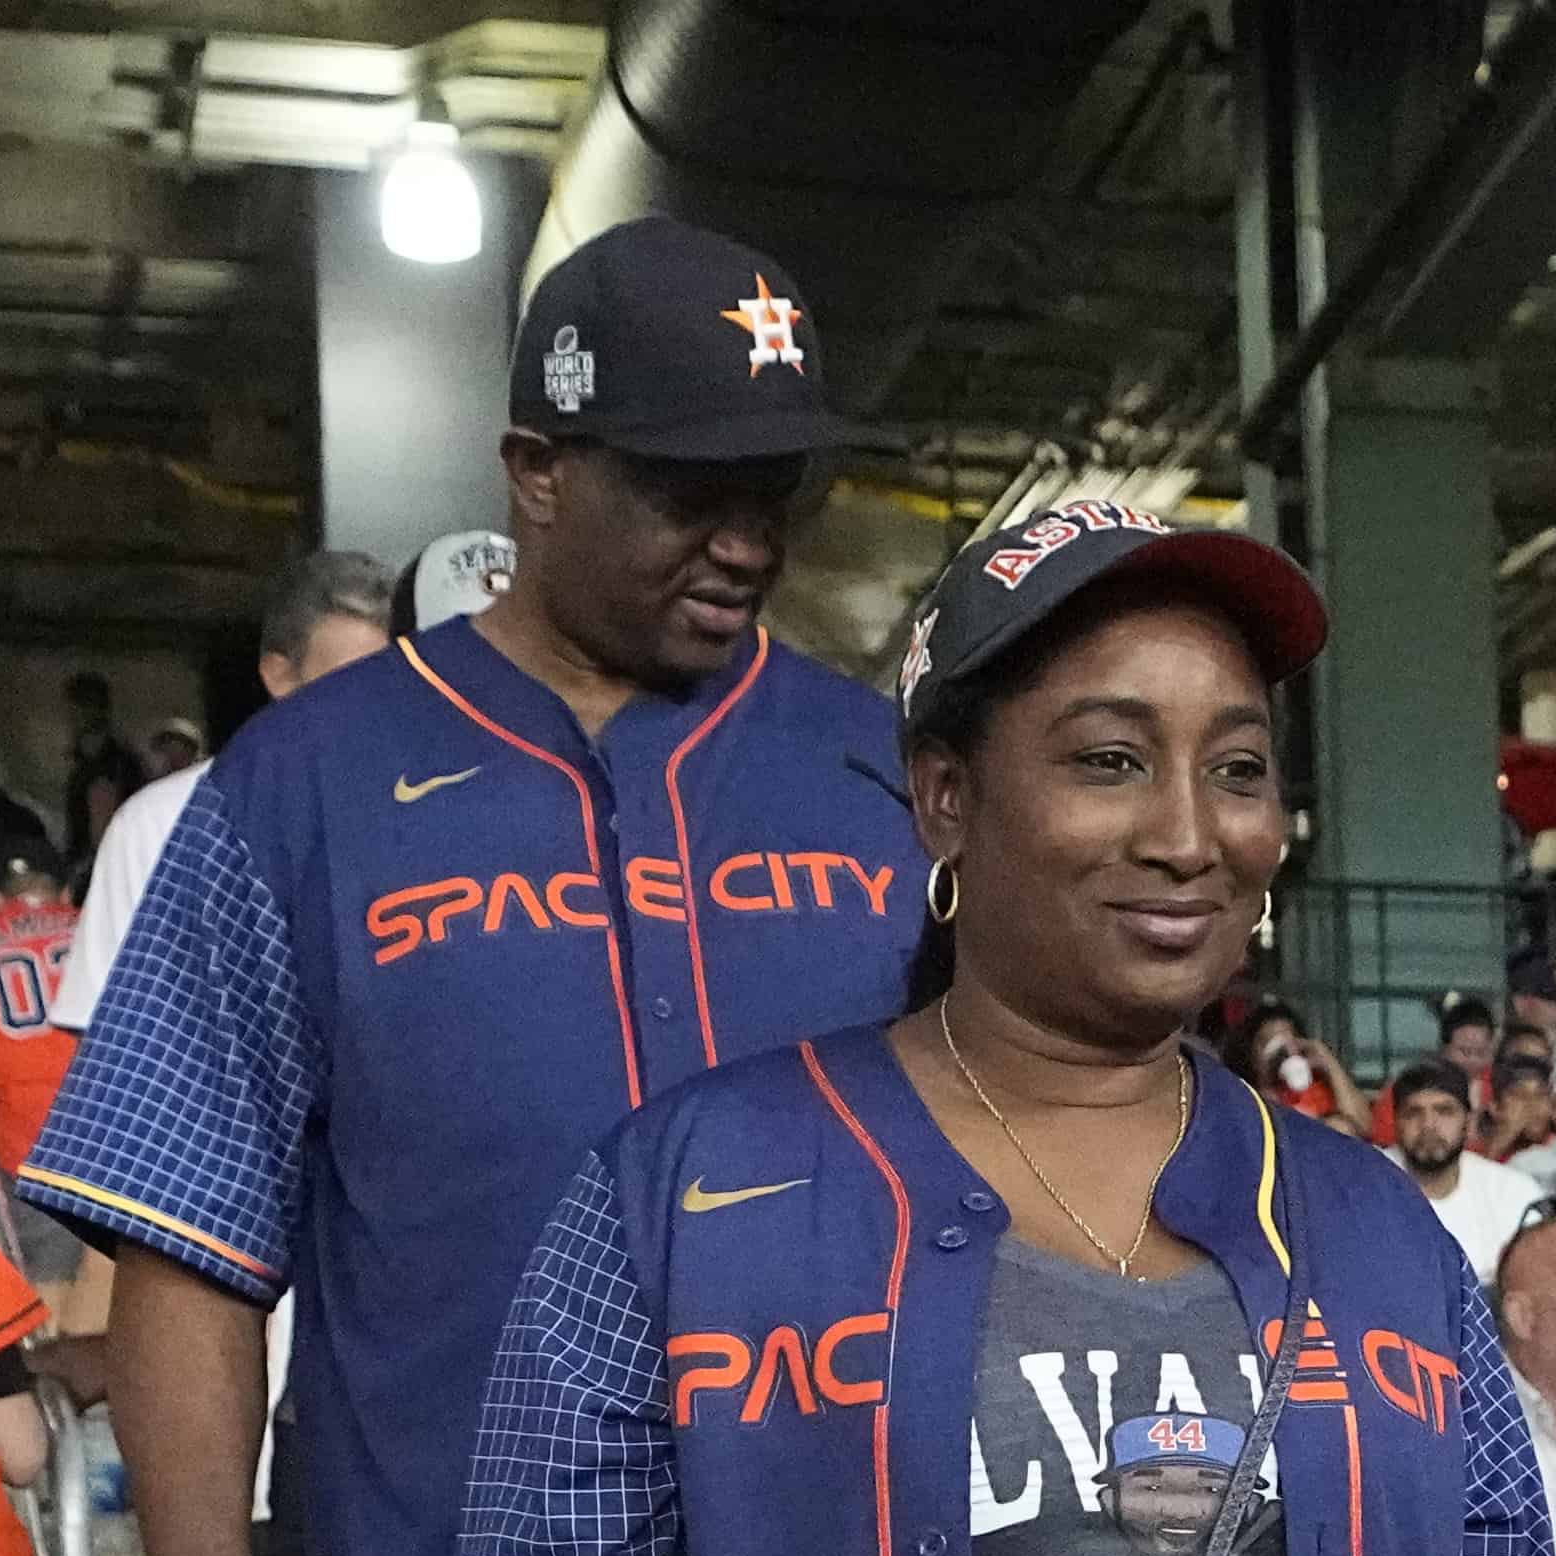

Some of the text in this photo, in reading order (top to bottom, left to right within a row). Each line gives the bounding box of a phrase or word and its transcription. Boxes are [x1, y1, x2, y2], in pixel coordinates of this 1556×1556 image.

[544, 353, 594, 375] WORLD
[545, 375, 594, 397] SERIES
[366, 851, 894, 966] SPACE CITY
[1148, 1417, 1206, 1452] 44
